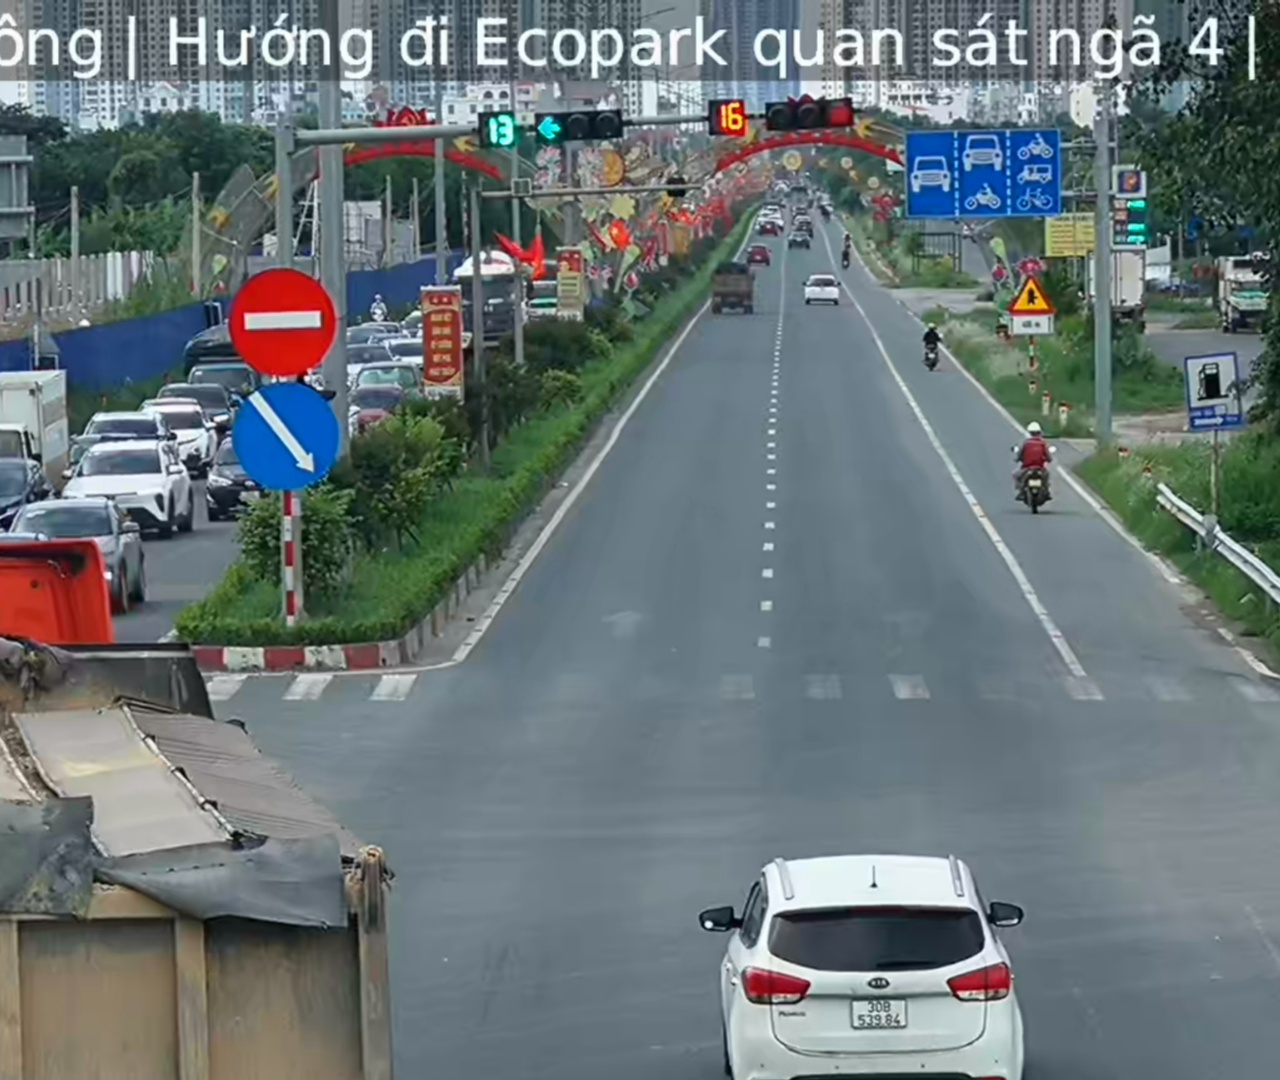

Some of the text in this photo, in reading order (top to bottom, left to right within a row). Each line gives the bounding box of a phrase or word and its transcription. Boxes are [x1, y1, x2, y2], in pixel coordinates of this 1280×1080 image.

[488, 115, 514, 145] 13
[721, 102, 745, 130] 16
[858, 1014, 900, 1026] 539.84
